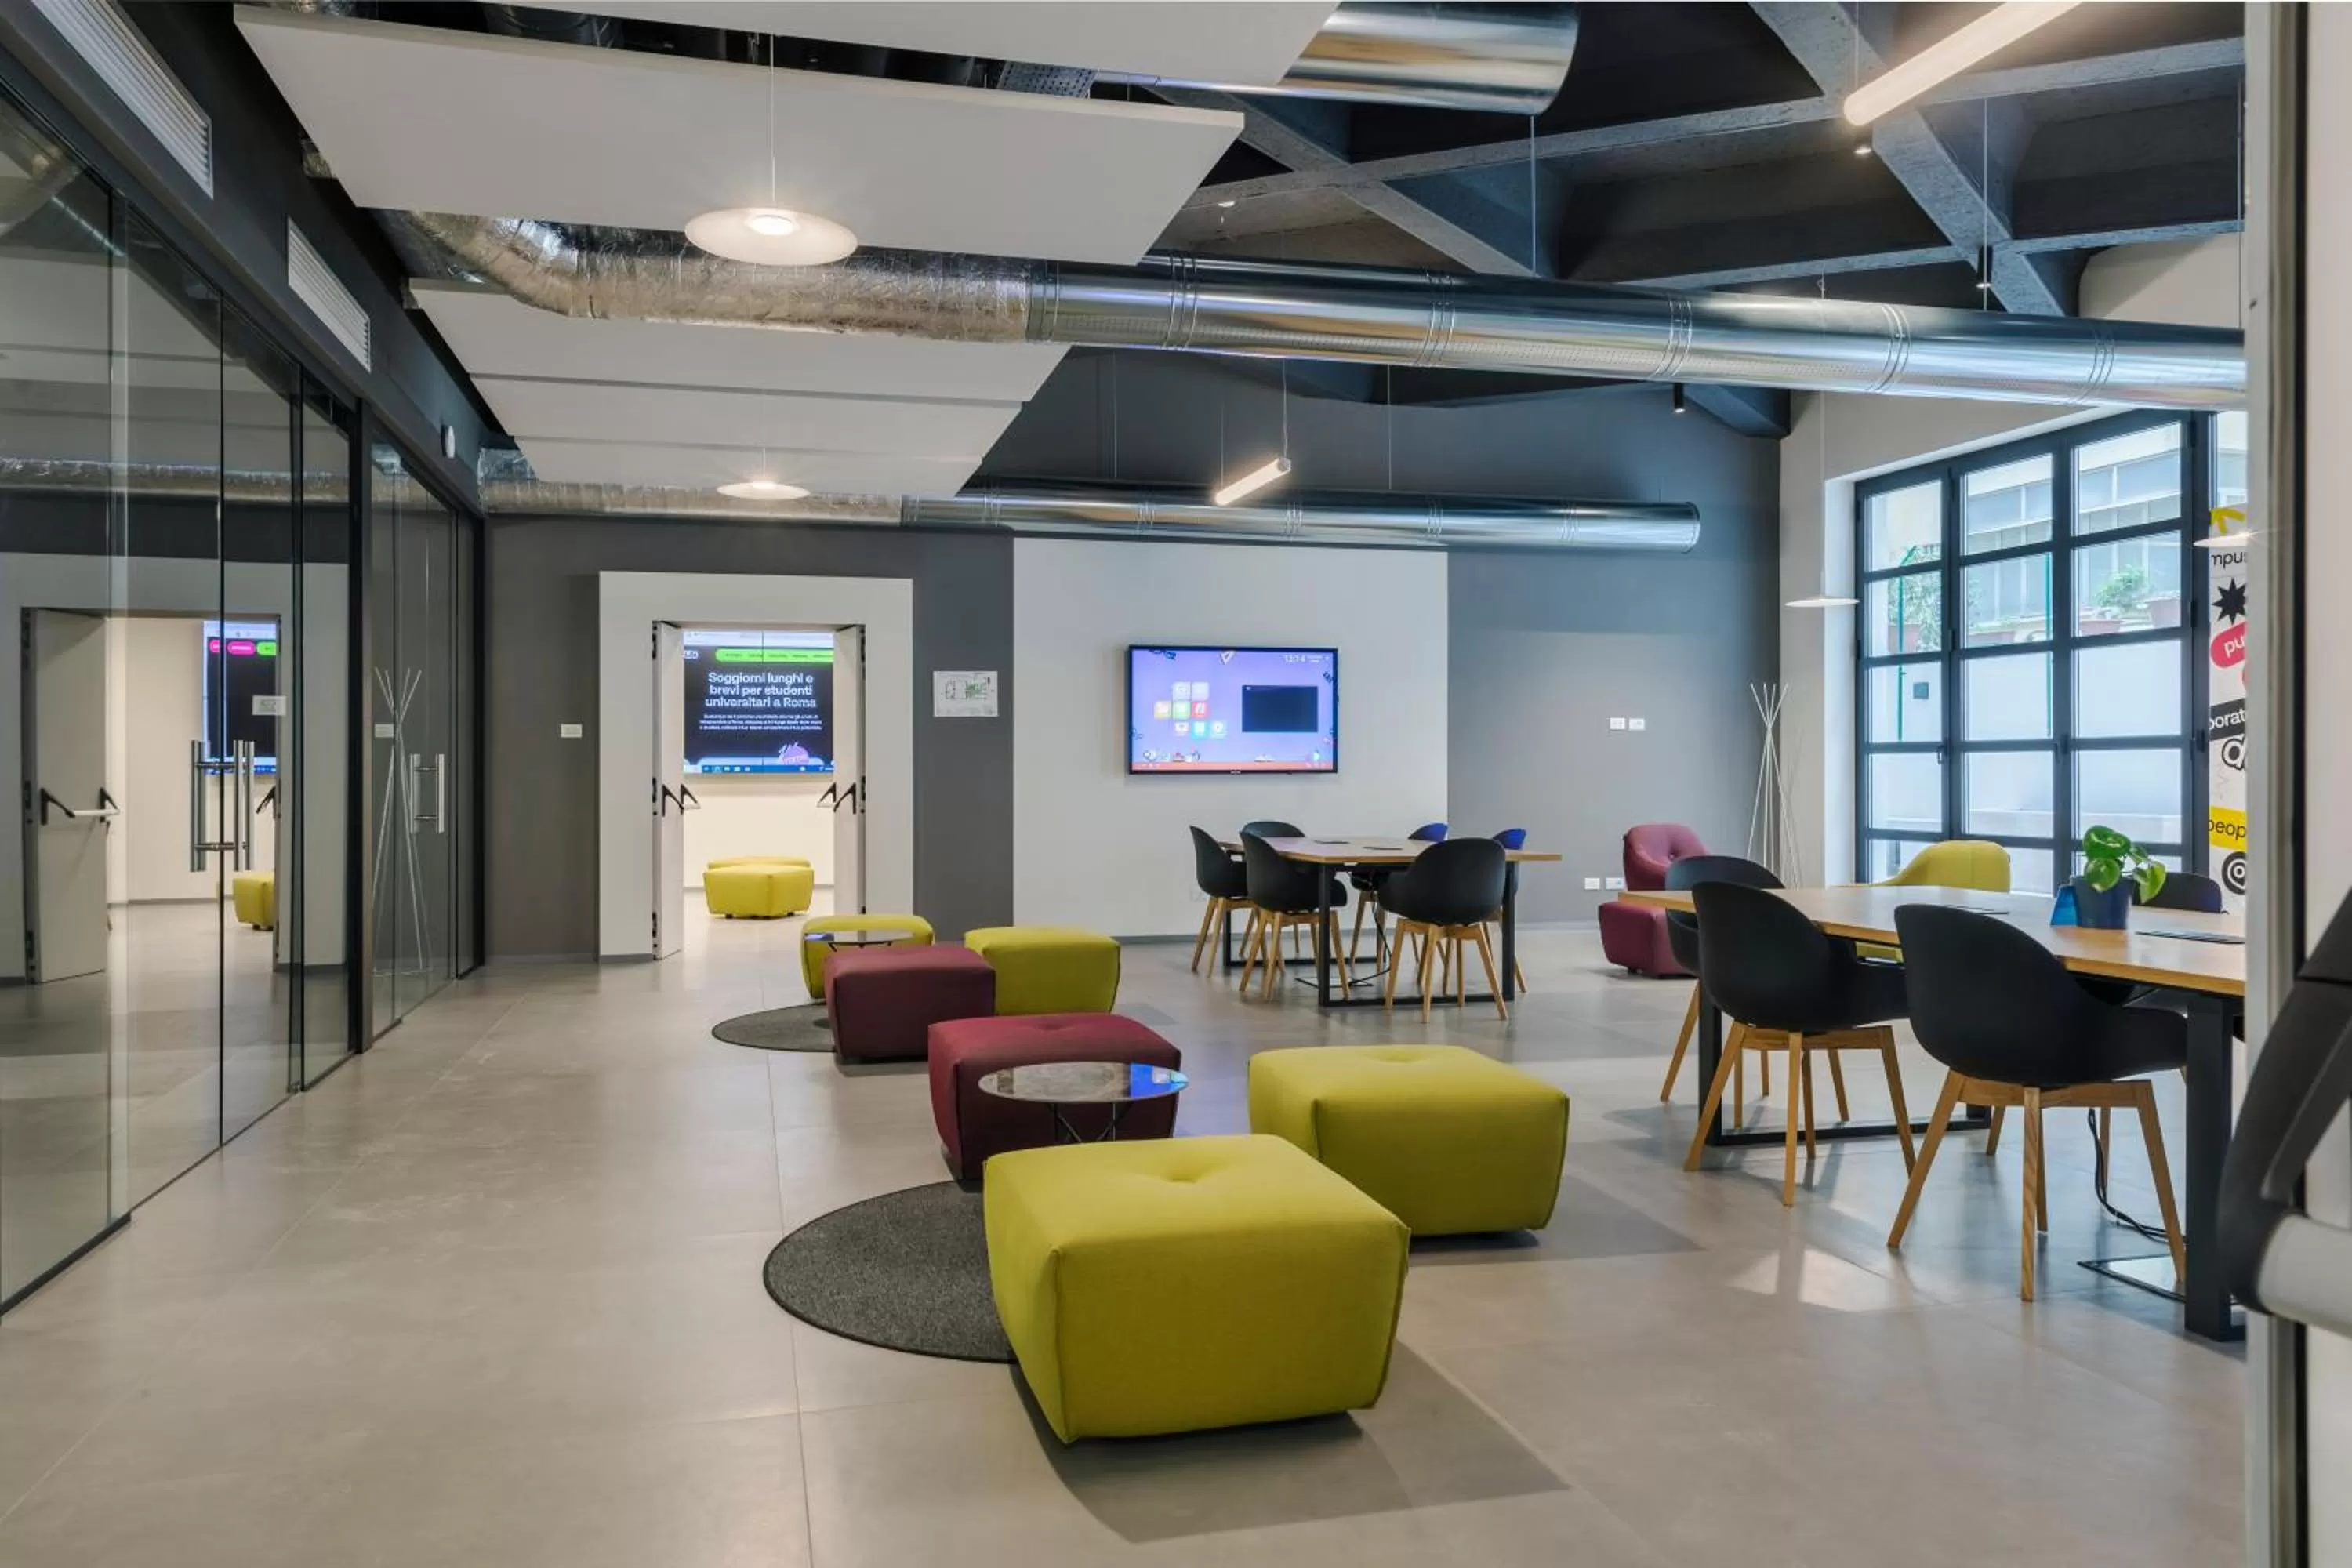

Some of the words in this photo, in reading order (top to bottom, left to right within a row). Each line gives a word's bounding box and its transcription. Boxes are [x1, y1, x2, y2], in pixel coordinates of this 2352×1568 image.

[709, 672, 765, 684] Soggiorni
[768, 673, 804, 684] lunghi
[710, 685, 739, 695] brevi
[742, 687, 762, 696] per
[764, 685, 813, 695] studenti
[705, 697, 771, 707] universitari
[773, 699, 781, 707] a
[783, 697, 817, 707] Roma
